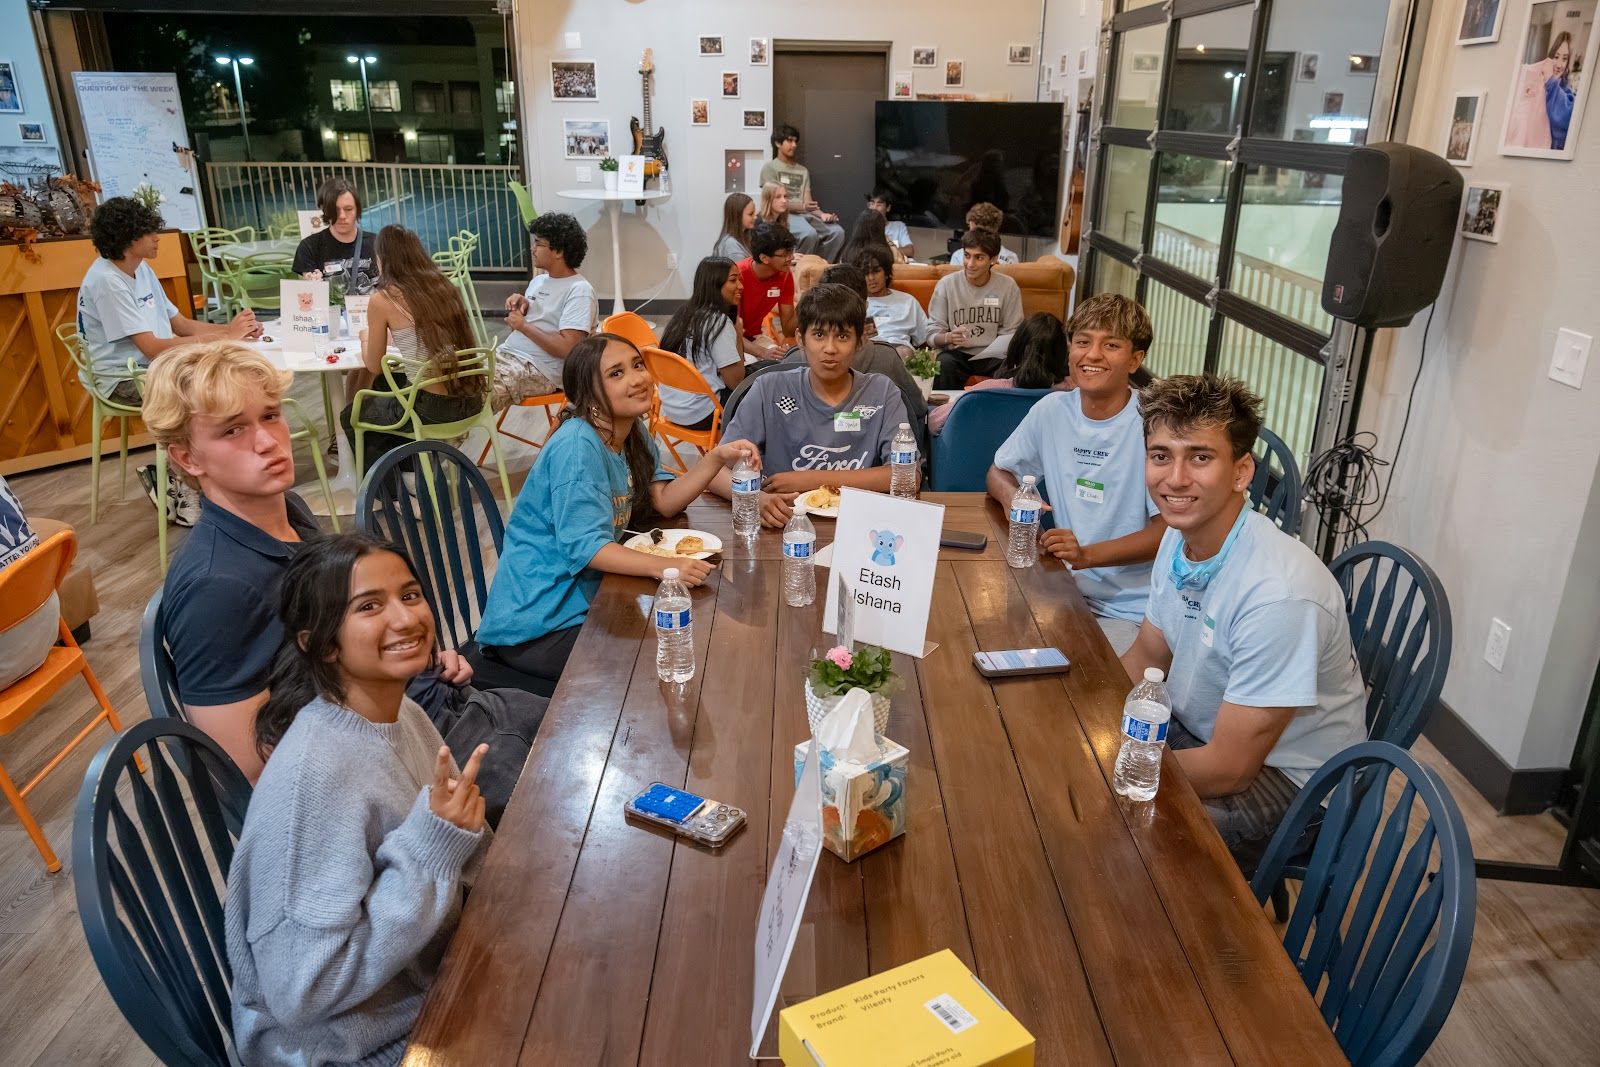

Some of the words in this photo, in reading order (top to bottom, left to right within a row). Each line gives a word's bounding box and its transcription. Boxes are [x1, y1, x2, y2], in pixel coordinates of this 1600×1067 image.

[953, 306, 1001, 327] COORAD
[293, 324, 312, 333] Roha
[791, 444, 869, 471] Ford
[859, 567, 901, 590] Etash
[853, 588, 902, 614] Ishana
[810, 1003, 847, 1020] Product:
[853, 993, 873, 1004] Kids
[874, 984, 897, 997] Party
[897, 973, 925, 988] Favors
[816, 1014, 847, 1030] Brand:
